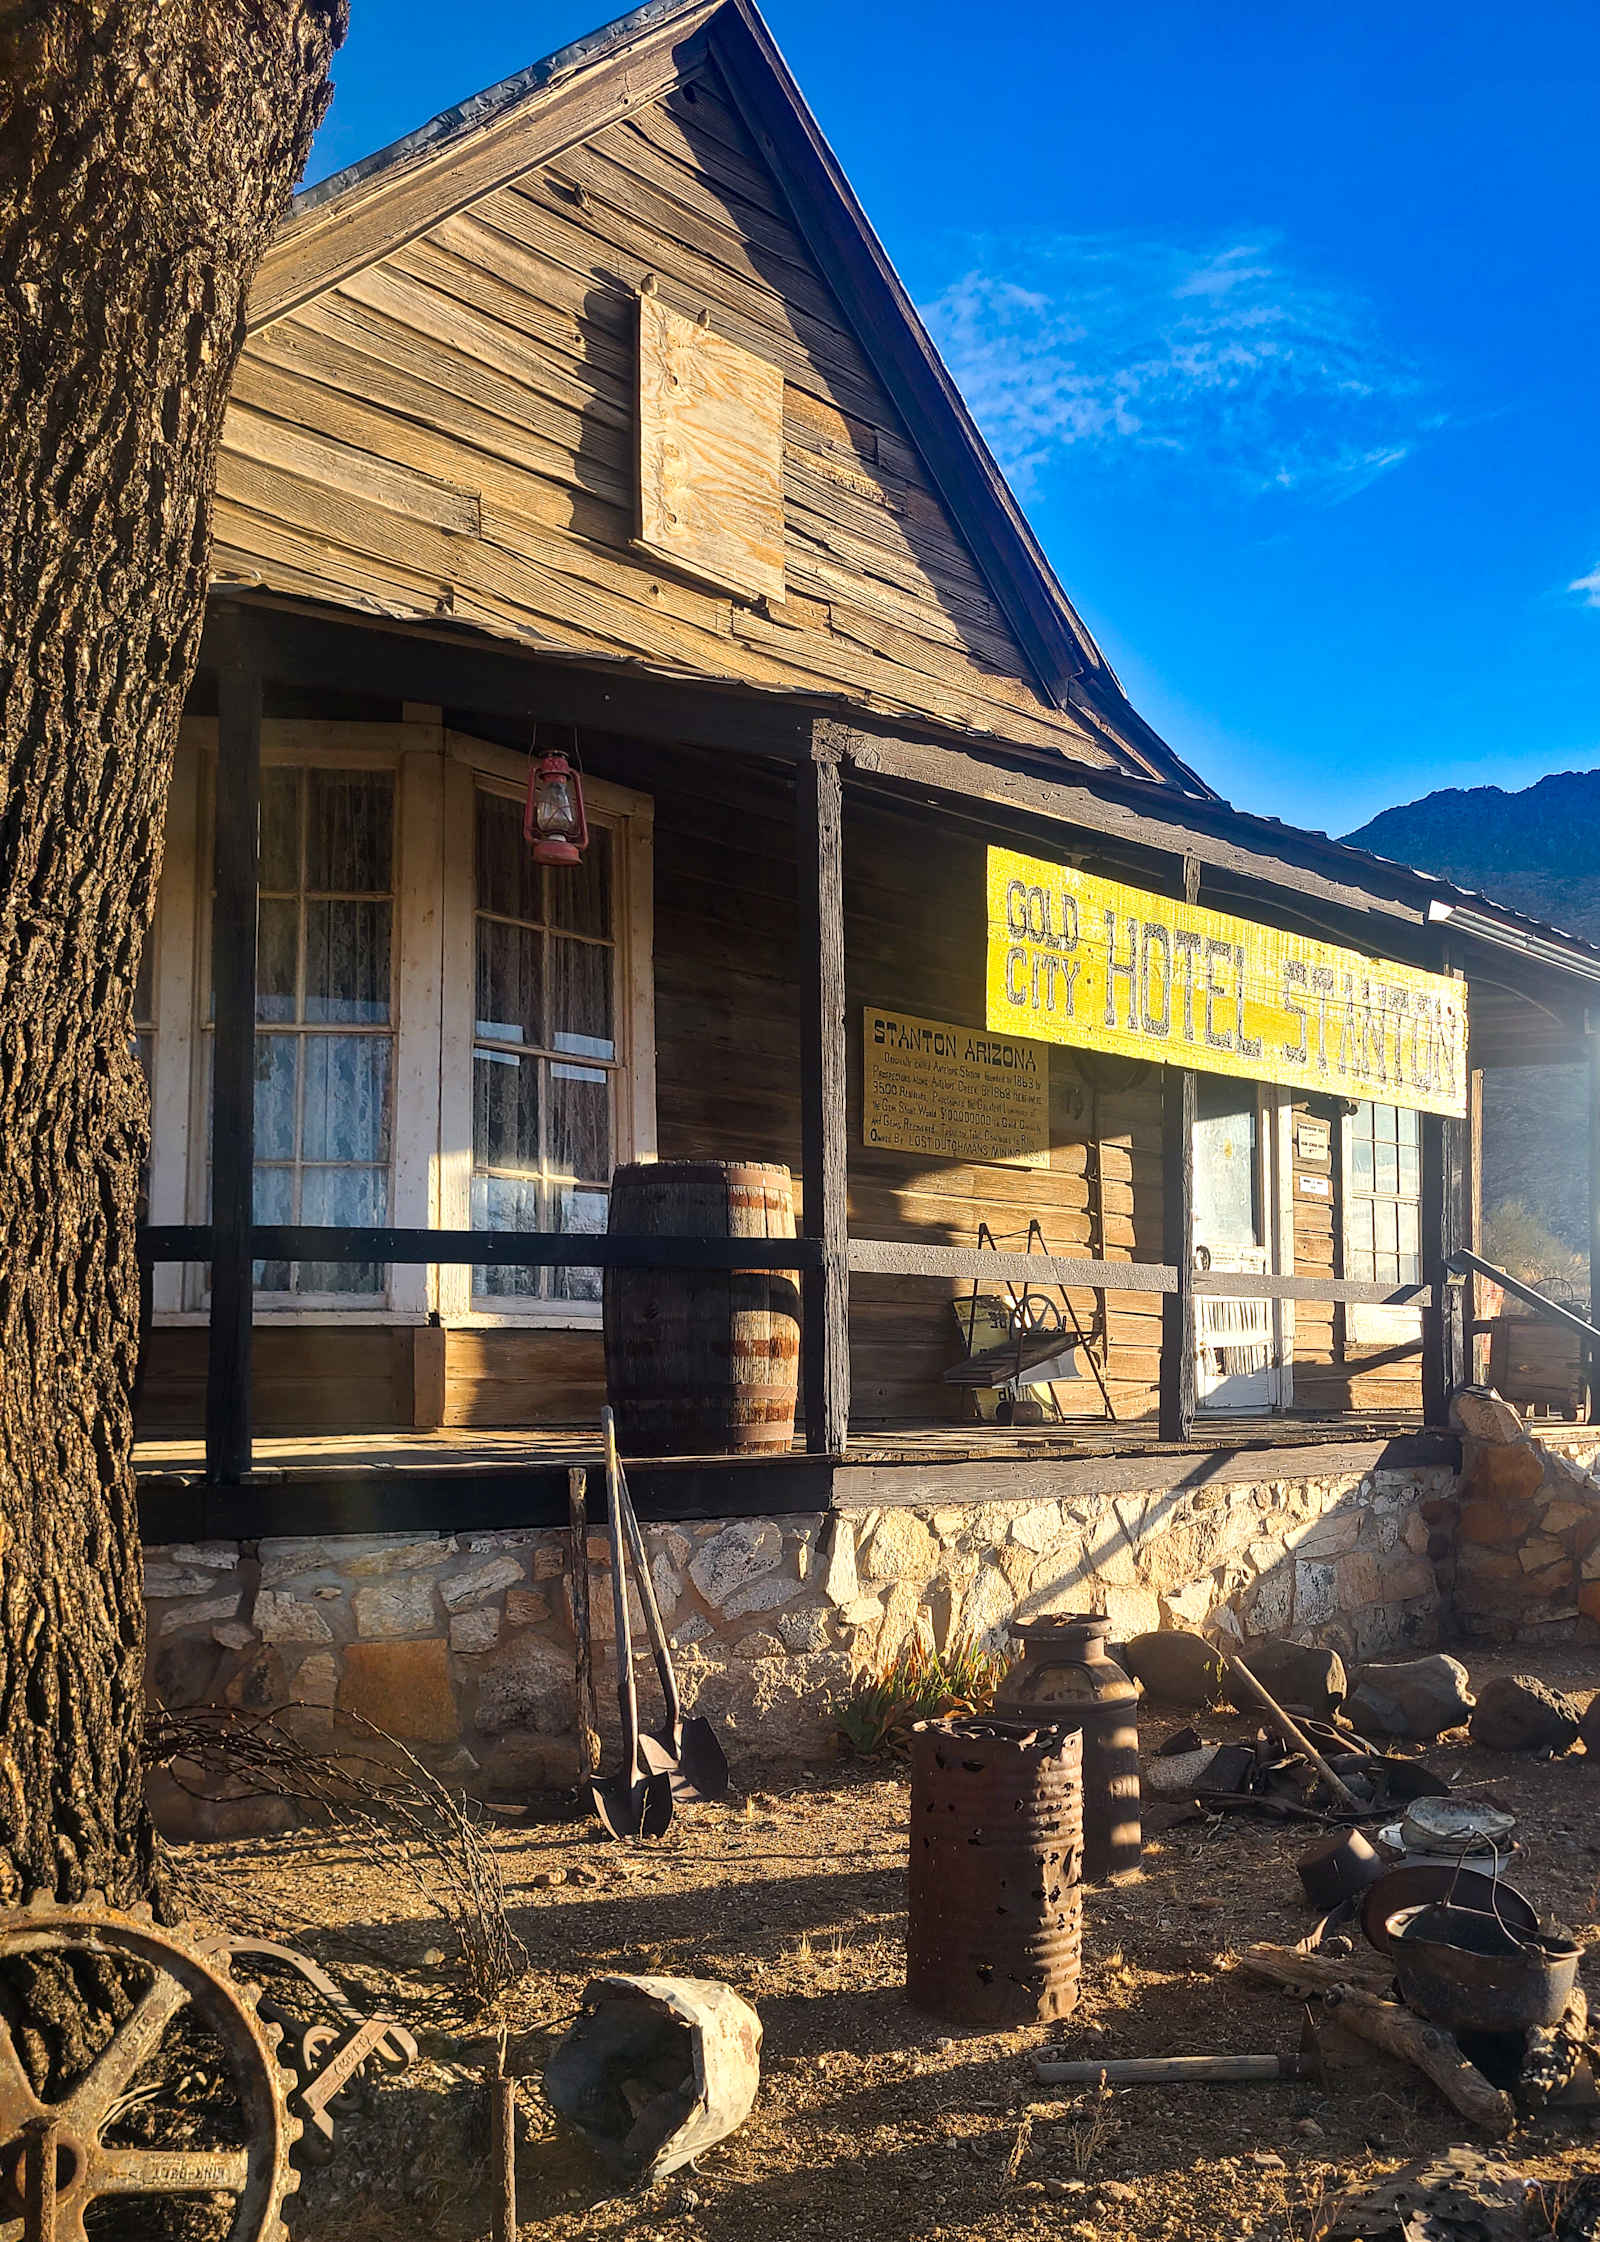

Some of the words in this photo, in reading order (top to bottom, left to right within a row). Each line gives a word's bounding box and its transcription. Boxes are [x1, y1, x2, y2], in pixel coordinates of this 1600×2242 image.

[1006, 947, 1080, 1016] CITY
[1007, 879, 1078, 952] GOLD
[1104, 909, 1262, 1056] HOTEL
[1283, 959, 1456, 1098] STANTON
[874, 1019, 957, 1057] STANTON
[965, 1038, 1036, 1072] ARIZONA
[908, 1135, 932, 1149] LOST
